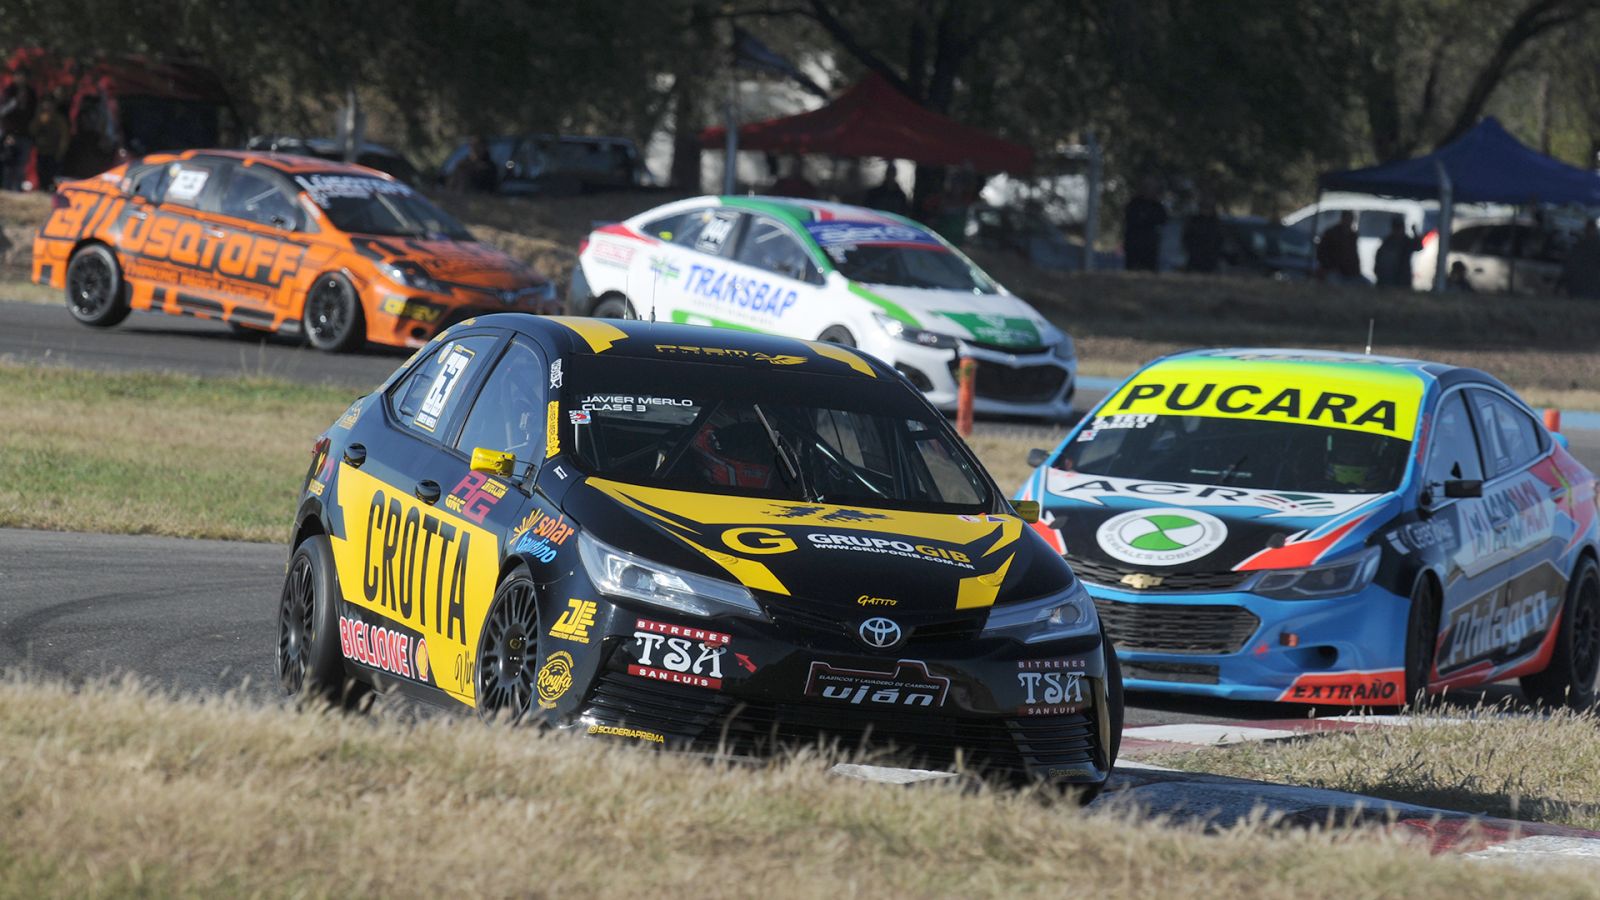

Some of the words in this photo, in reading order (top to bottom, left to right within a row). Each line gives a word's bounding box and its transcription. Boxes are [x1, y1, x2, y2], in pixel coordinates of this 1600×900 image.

[684, 264, 798, 318] TRANSBAP
[581, 395, 634, 404] JAVIER
[638, 397, 693, 407] MERLO
[582, 403, 633, 411] CLASE
[636, 404, 646, 412] 3
[1117, 383, 1396, 431] PUCARA
[533, 514, 575, 545] solar
[720, 527, 798, 555] G
[807, 533, 972, 563] GRUPOGIB
[813, 543, 976, 570] WWW.GRUPOGIB.COM.AR
[363, 489, 471, 646] CROTTA
[637, 619, 730, 643] BITRENES
[339, 615, 411, 678] BIGLIONE
[633, 631, 728, 679] TSA
[639, 668, 668, 680] SAN
[673, 674, 709, 687] LUIS
[1018, 660, 1086, 668] BITRENES
[822, 685, 934, 706] uján
[1017, 671, 1086, 704] TSA
[1292, 678, 1397, 699] EXTRAÑO
